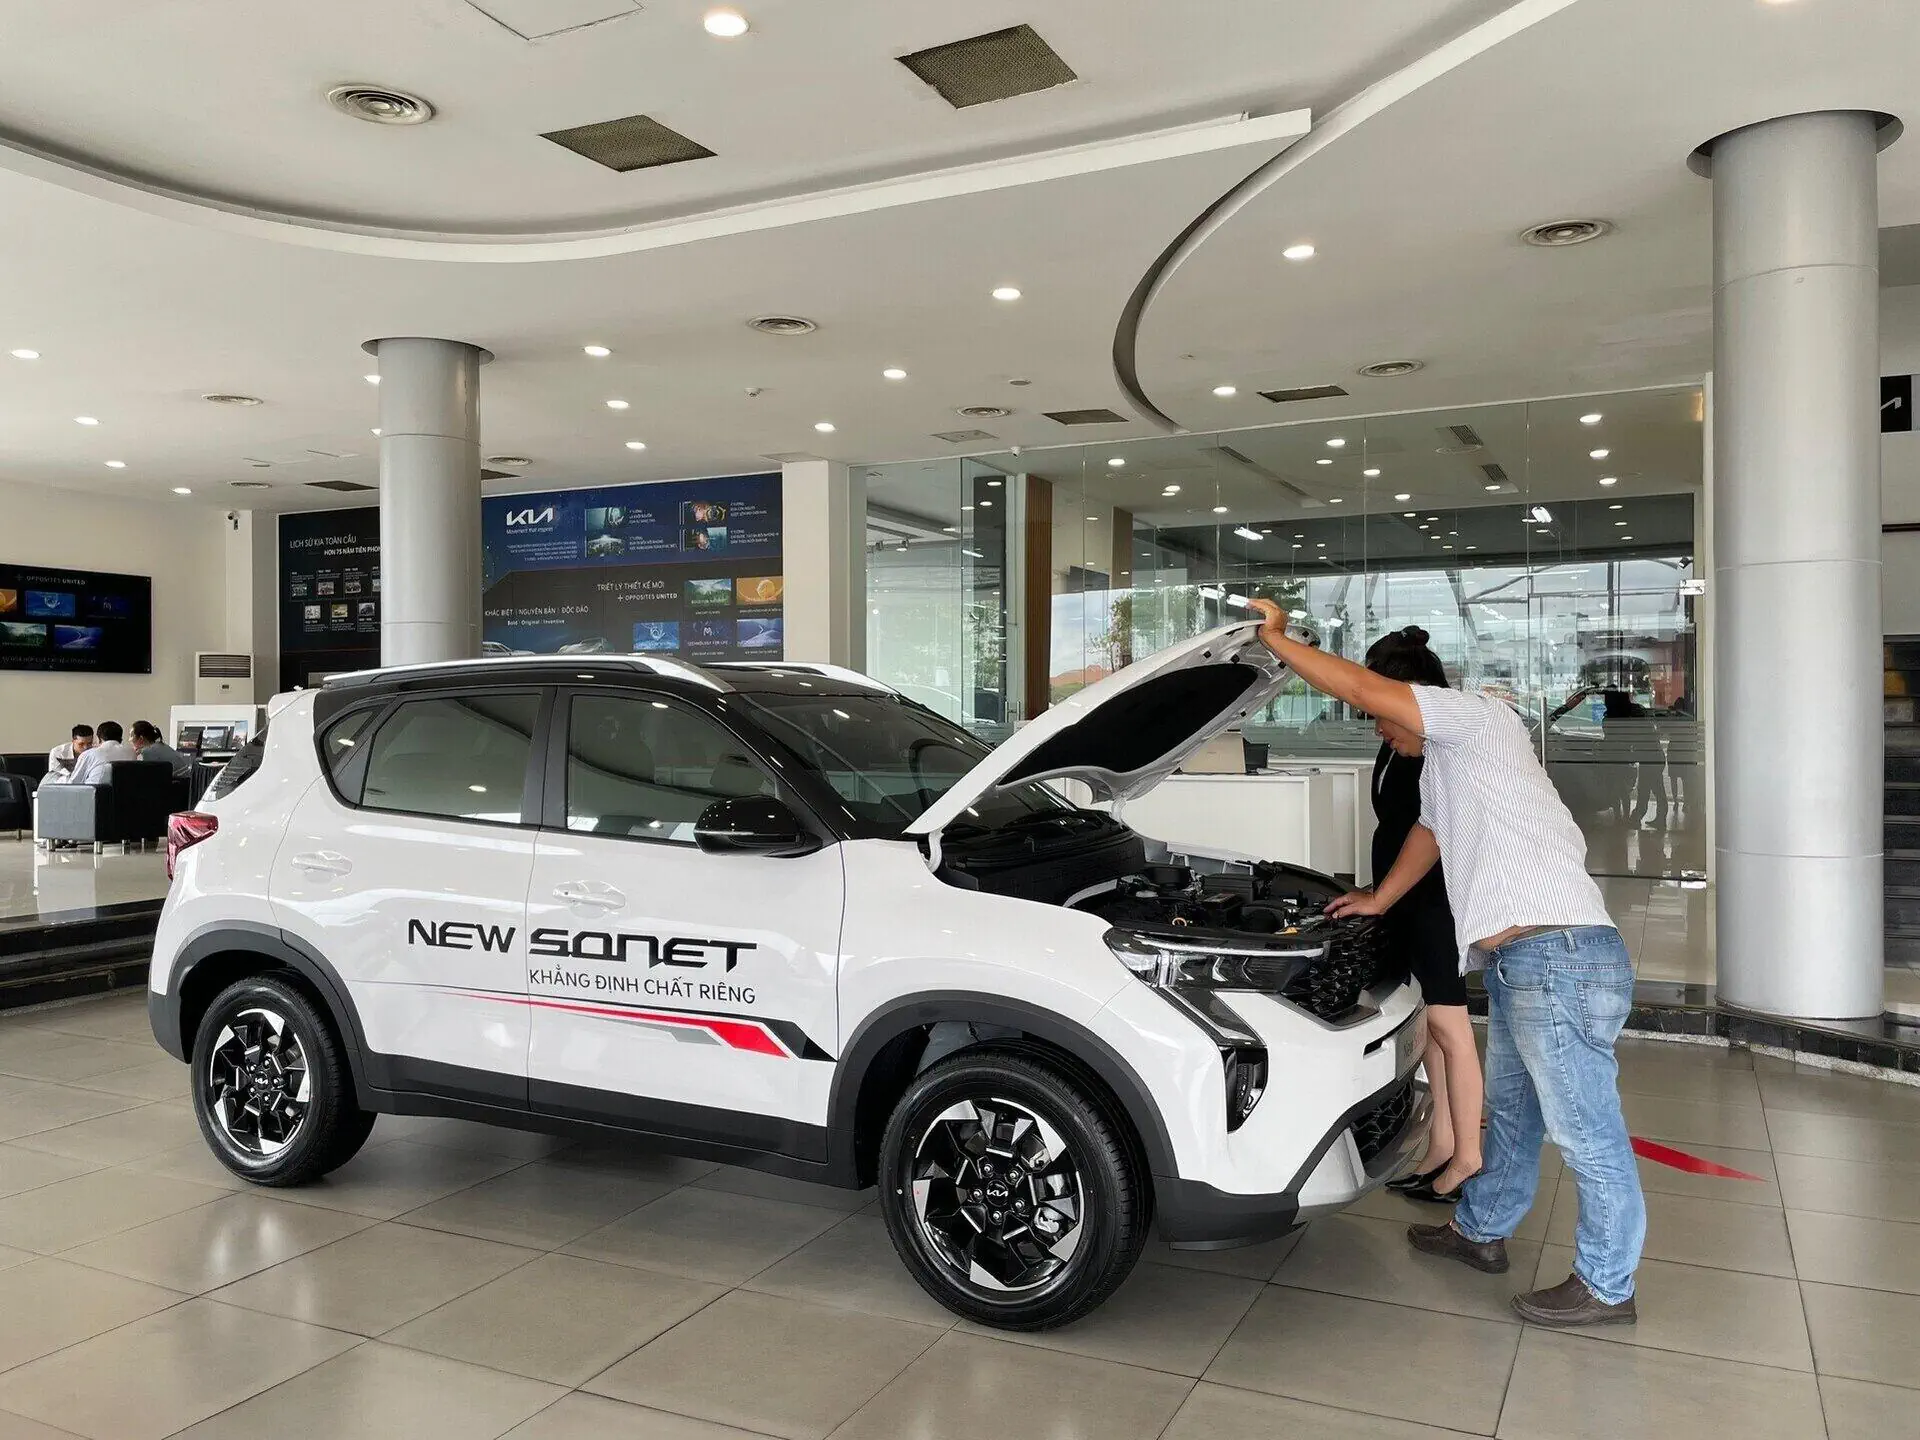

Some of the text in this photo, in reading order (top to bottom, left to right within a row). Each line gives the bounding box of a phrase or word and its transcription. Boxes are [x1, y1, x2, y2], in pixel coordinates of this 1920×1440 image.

[506, 507, 554, 526] KIA
[625, 592, 678, 601] OPPOSITES UNITED
[407, 918, 758, 973] NEW SONET
[529, 963, 757, 1005] KHẲNG ĐỊNH CHẤT RIÊNG
[986, 1188, 1008, 1197] KIA
